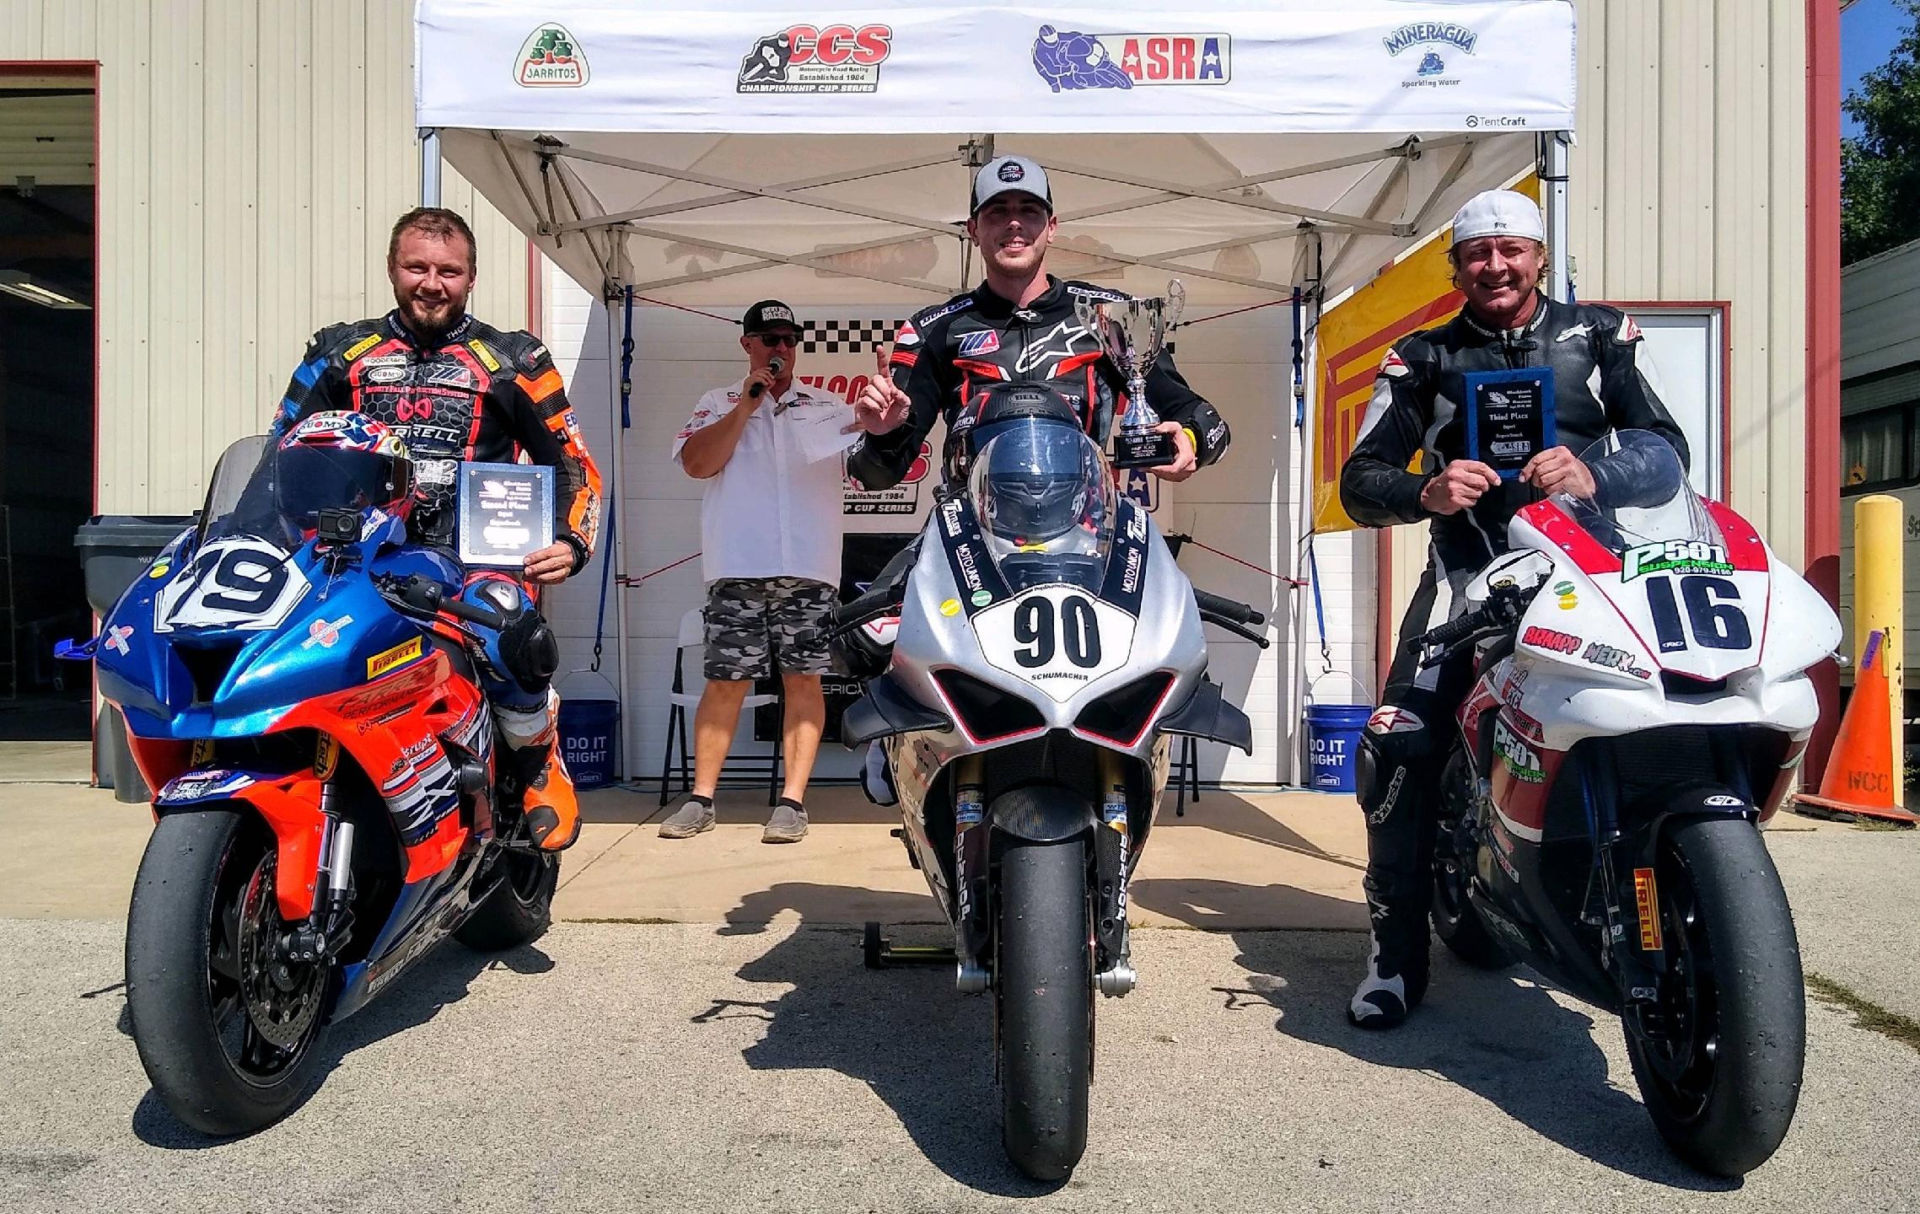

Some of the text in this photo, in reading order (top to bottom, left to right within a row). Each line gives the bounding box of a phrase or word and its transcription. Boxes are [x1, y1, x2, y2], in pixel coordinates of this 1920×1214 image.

[787, 25, 891, 65] CCS
[1386, 24, 1475, 54] MINERAGUA
[1121, 37, 1224, 80] ASRA
[526, 67, 577, 79] JARRITOS
[739, 84, 876, 92] CHAMPIONSHIP CUP SERIES
[1402, 80, 1437, 88] Sparkling
[1479, 117, 1526, 126] TentCraft
[1488, 412, 1509, 421] Third
[394, 426, 460, 445] RRELL
[844, 492, 882, 500] tablished
[854, 504, 875, 512] CUP
[877, 504, 914, 512] SERIES
[1638, 558, 1734, 573] SUSPENSION
[1645, 575, 1750, 654] 16
[1013, 595, 1102, 669] 90
[372, 642, 417, 672] PIRELLI
[1031, 672, 1089, 682] SCHUMACHER
[821, 681, 865, 697] ERICA
[566, 736, 607, 750] DO IT
[1309, 739, 1346, 753] DO IT
[566, 750, 607, 763] RIGHT
[1310, 753, 1346, 766] RIGHT
[1848, 769, 1888, 793] NCC
[956, 831, 971, 922] DUNLOP
[1115, 833, 1128, 921] DUNLOP
[1634, 869, 1662, 949] PIRELLI
